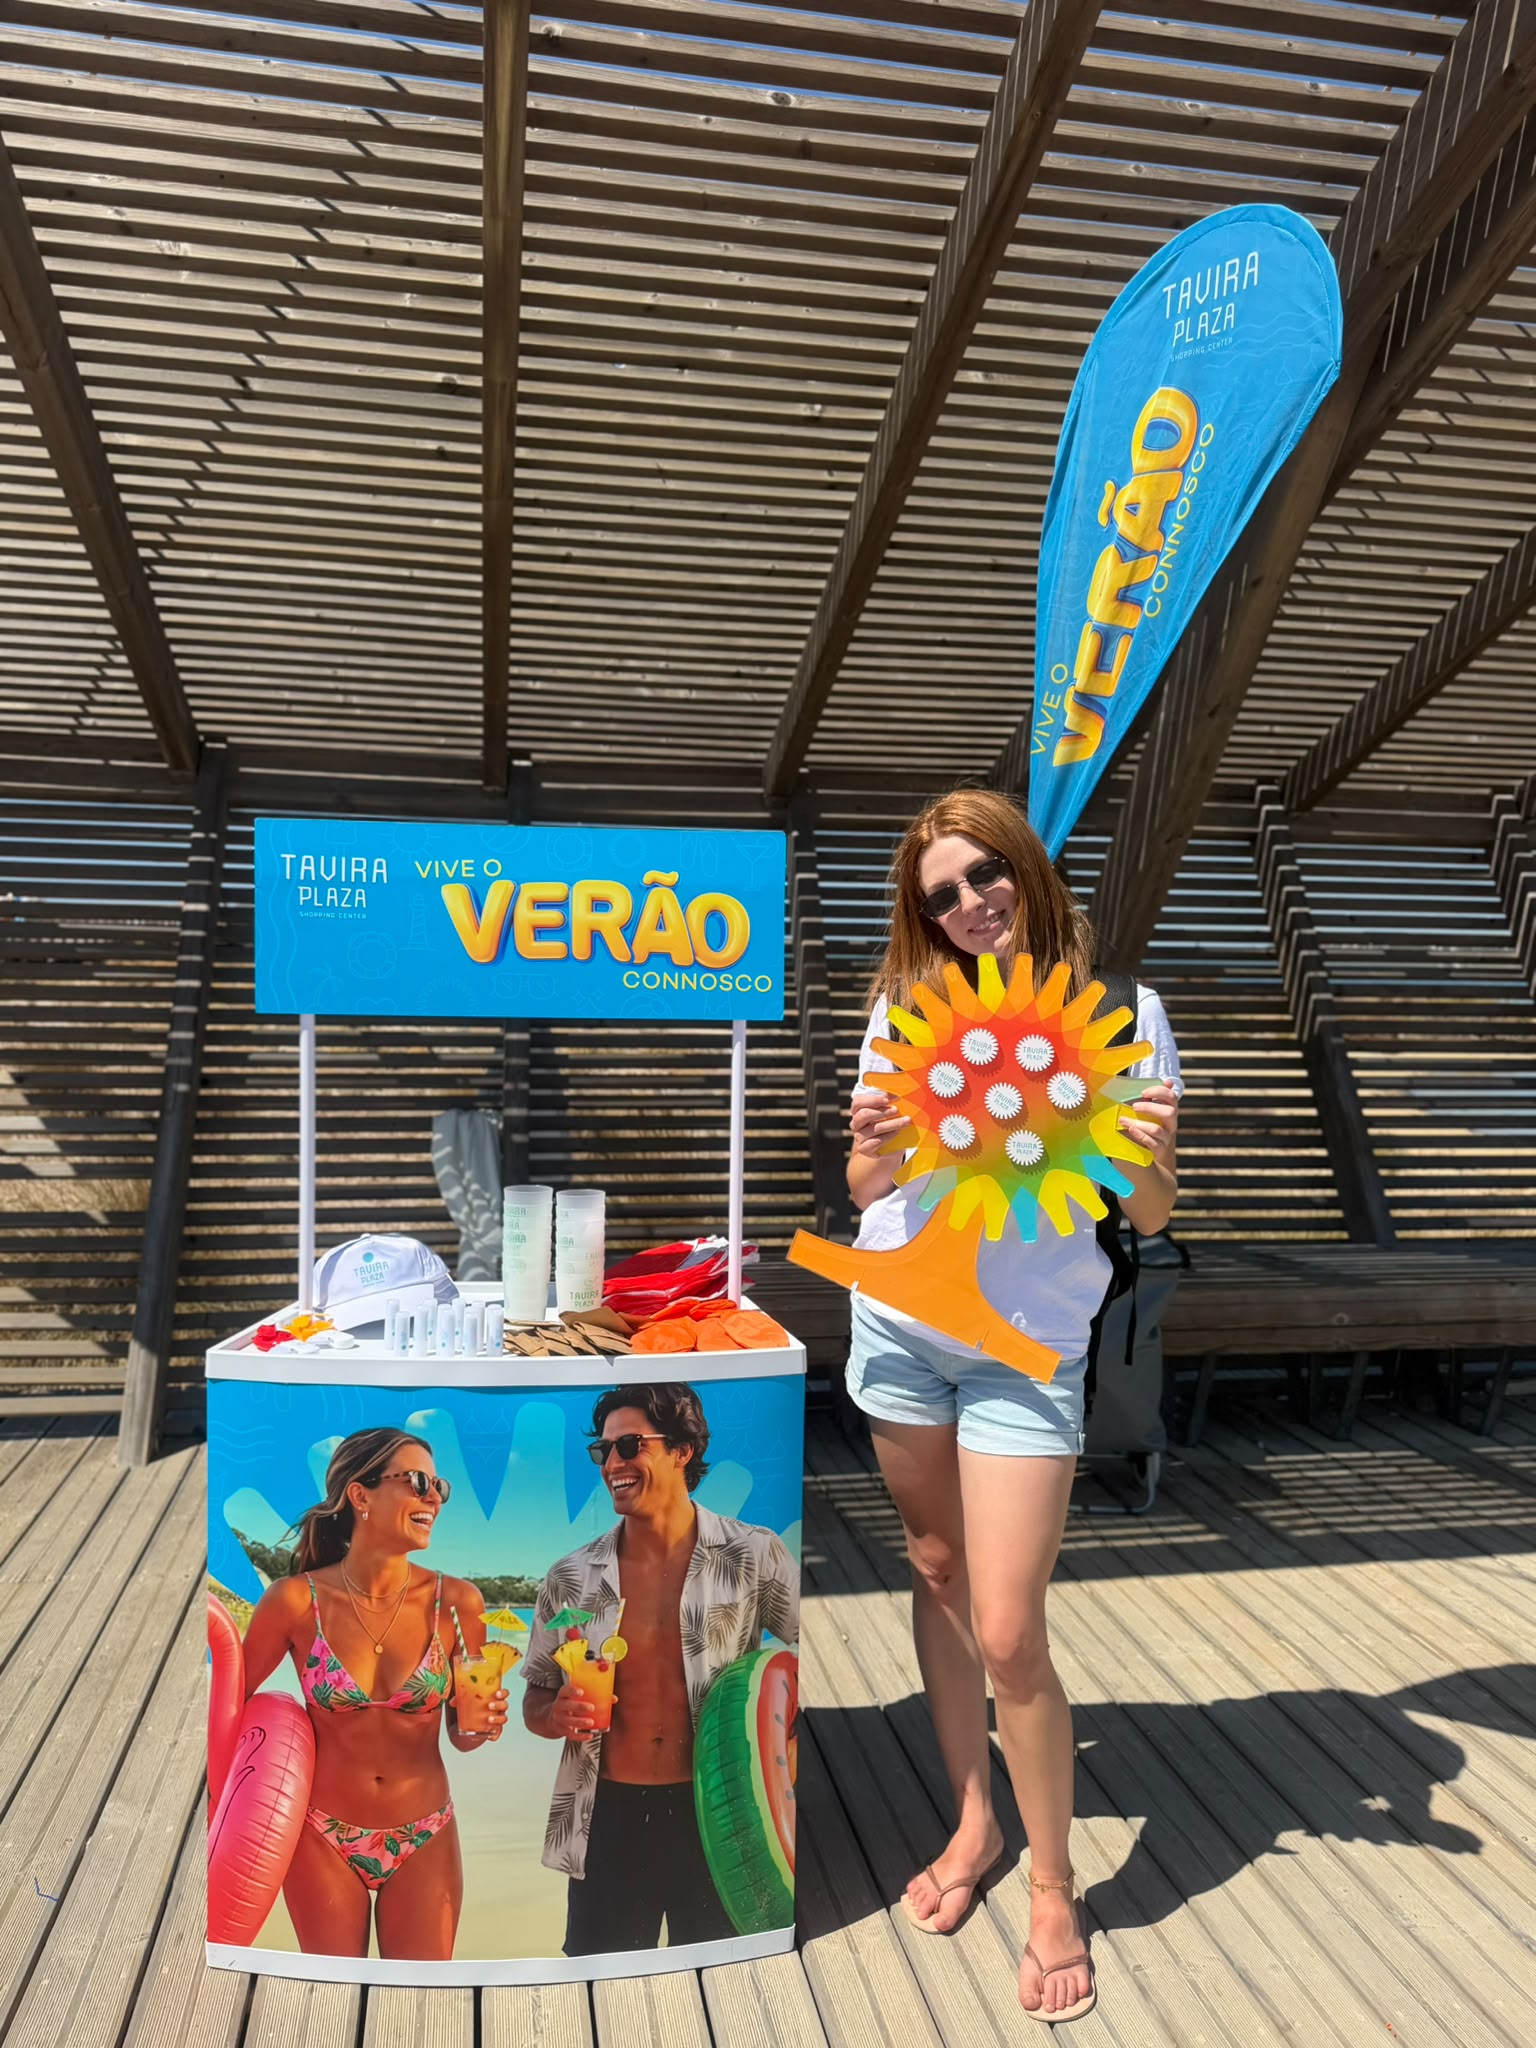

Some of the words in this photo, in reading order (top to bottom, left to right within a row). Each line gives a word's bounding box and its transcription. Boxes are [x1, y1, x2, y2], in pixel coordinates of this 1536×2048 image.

[1162, 251, 1260, 319] TAVIRA
[1172, 303, 1235, 348] PLAZA
[1171, 345, 1205, 362] SHOPPING
[1208, 337, 1233, 351] CENTER
[1144, 422, 1215, 619] CONNOSCO
[1052, 386, 1200, 767] VERÃO
[1030, 693, 1062, 755] VIVE
[1050, 663, 1069, 683] O
[280, 853, 388, 884] TAVIRA
[414, 860, 475, 879] VIVE
[482, 858, 502, 878] O
[297, 885, 367, 909] PLAZA
[299, 911, 336, 919] SHOPPING
[338, 912, 367, 920] CENTER
[441, 870, 751, 969] VERÃO
[622, 970, 773, 993] CONNOSCO
[968, 1038, 992, 1052] TAVIRA
[970, 1046, 987, 1055] PLAZA
[1023, 1046, 1048, 1055] TAVIRA
[1026, 1053, 1043, 1061] PLAZA
[936, 1069, 959, 1087] TAVIRA
[937, 1077, 953, 1090] PLAZA
[1056, 1086, 1071, 1100] PLAZA
[1058, 1078, 1080, 1098] TAVIRA
[993, 1090, 1017, 1109] TAVIRA
[994, 1099, 1010, 1111] PLAZA
[947, 1120, 969, 1140] TAVIRA
[947, 1128, 963, 1142] PLAZA
[1012, 1141, 1038, 1150] TAVIRA
[353, 1261, 390, 1277] TAVIRA
[361, 1272, 385, 1284] PLAZA
